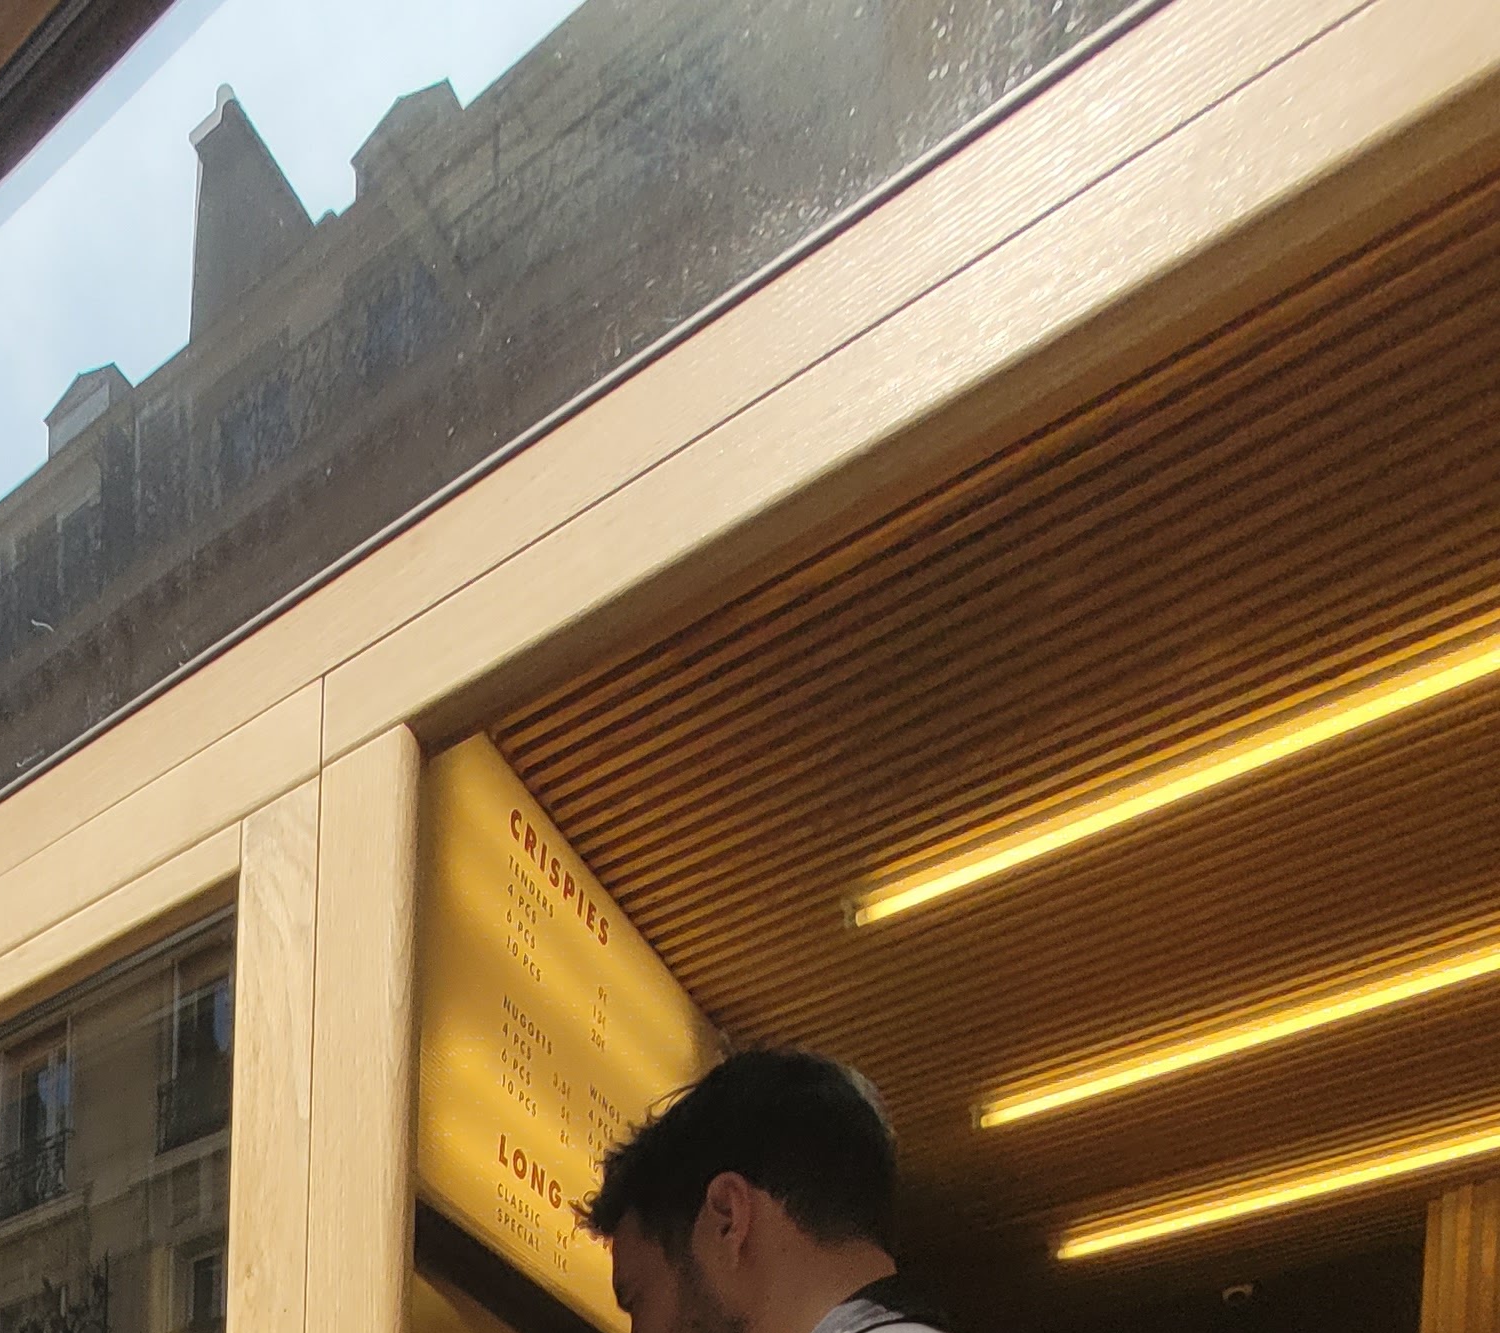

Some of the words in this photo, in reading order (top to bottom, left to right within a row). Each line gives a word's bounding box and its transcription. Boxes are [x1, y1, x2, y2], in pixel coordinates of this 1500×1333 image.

[508, 854, 554, 918] TENDERS
[509, 808, 609, 946] CRISPIES
[506, 908, 512, 923] 6
[517, 919, 536, 950] PCS
[518, 895, 537, 925] PCS
[506, 935, 519, 957] 10
[522, 952, 541, 982] PCS
[503, 994, 552, 1055] NUGGETS
[513, 1032, 532, 1060] PCS
[501, 1047, 507, 1063] 6
[513, 1058, 531, 1086] PCS
[502, 1073, 514, 1095] 10
[518, 1090, 537, 1117] PCS
[498, 1133, 562, 1209] LONG
[498, 1182, 541, 1228] CLASSIC
[497, 1208, 540, 1252] SPECIAL
